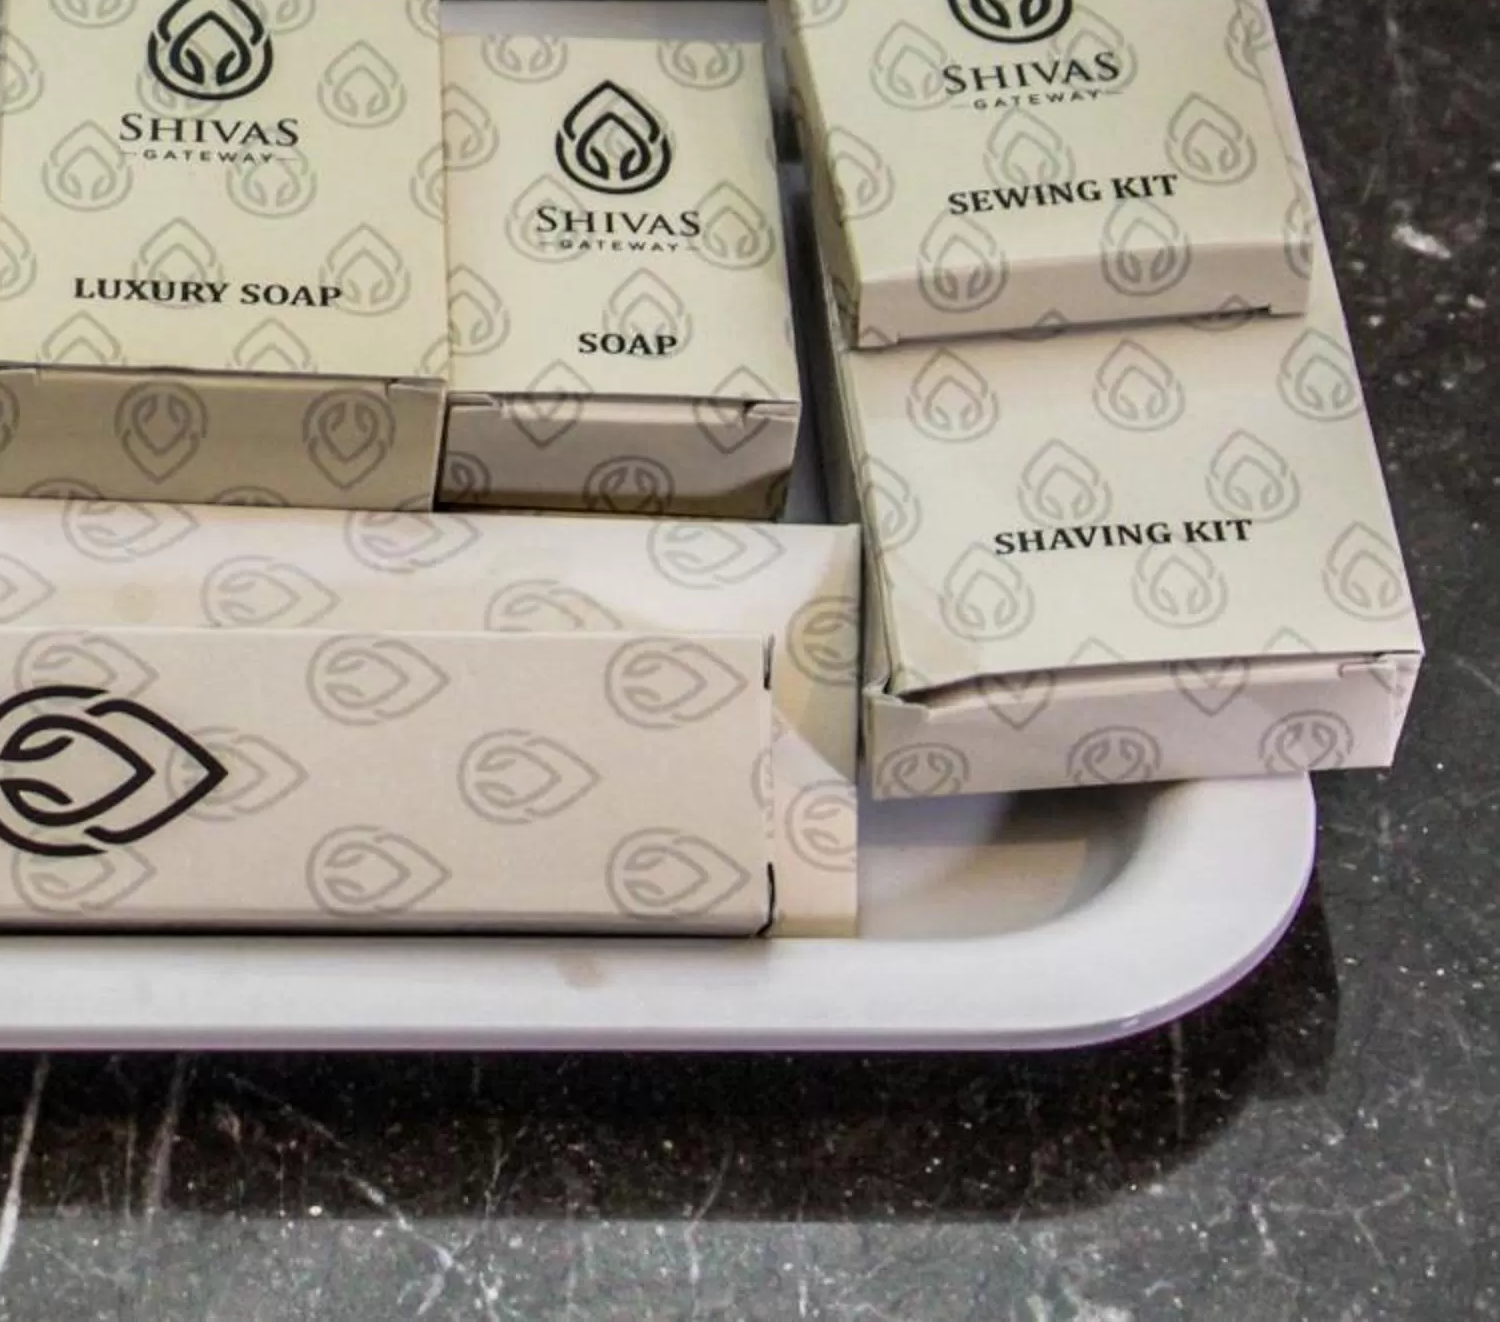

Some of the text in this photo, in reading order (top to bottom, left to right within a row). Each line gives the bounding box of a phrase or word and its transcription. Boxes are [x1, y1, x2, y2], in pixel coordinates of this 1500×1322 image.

[942, 51, 1121, 96] SHIVAS
[973, 89, 1100, 110] GATEWAY
[119, 113, 299, 147] SHIVAS
[143, 149, 274, 163] GATEWAY
[948, 174, 1178, 215] SEWING KIT
[537, 206, 701, 238] SHIVAS
[560, 239, 679, 253] GATEWAY
[74, 278, 342, 308] LUXURY SOAP
[579, 333, 678, 356] SOAP
[995, 519, 1253, 555] SHAVING KIT
